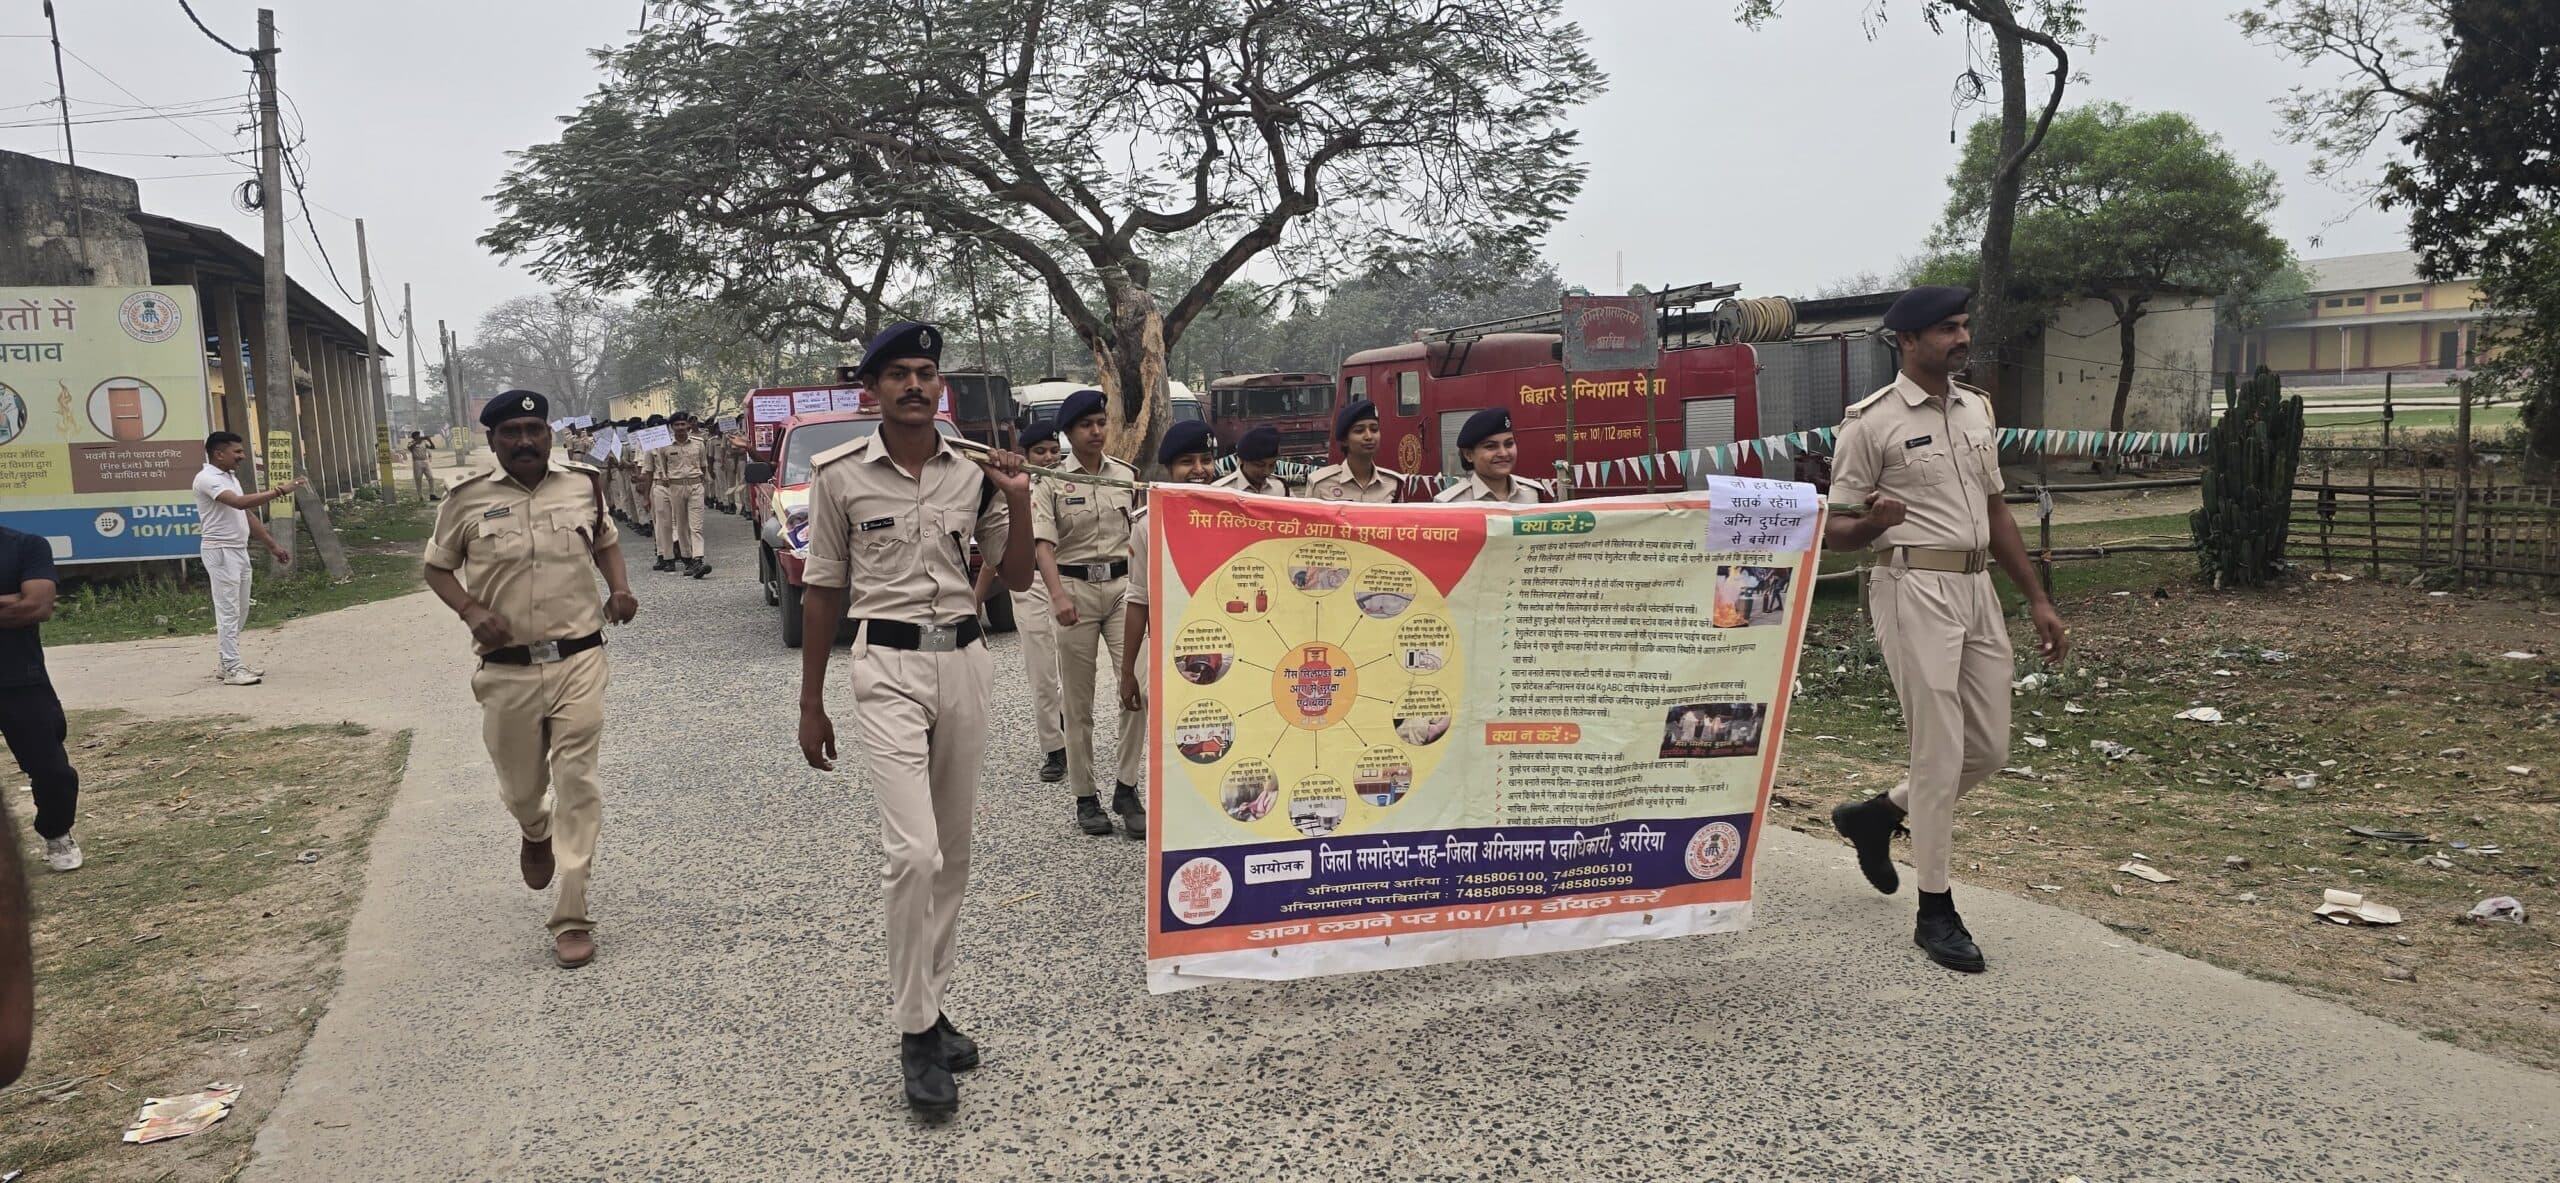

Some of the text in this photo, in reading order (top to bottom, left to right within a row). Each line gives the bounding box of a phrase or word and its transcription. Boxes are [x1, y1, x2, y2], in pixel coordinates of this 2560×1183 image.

[0, 299, 76, 330] तों में
[1519, 384, 1557, 405] बिहार
[134, 449, 156, 458] फायर
[100, 461, 121, 471] (Fire
[122, 460, 142, 471] Exit)
[270, 471, 291, 481] 15545
[1730, 494, 1798, 509] सतर्क रहेगा
[1187, 509, 1460, 544] गैस सिलेण्डर की आग से सुरक्षा एवं बचाव
[1520, 519, 1547, 533] क्या
[1551, 513, 1577, 532] करें
[1723, 513, 1802, 530] अग्नि दुर्घटना
[1730, 531, 1742, 545] से
[1748, 532, 1780, 545] बचेगा
[1284, 668, 1298, 679] गैस
[1491, 730, 1517, 743] क्या
[1520, 730, 1532, 741] न
[1536, 726, 1562, 742] करें
[1319, 842, 1353, 874] जिला
[1481, 832, 1546, 863] अग्निशमन
[1550, 827, 1615, 862] पदाधिकारी,
[1619, 823, 1667, 851] अररिया
[1249, 859, 1305, 875] आयोजक
[1306, 880, 1390, 896] अग्निशमालय
[1393, 875, 1441, 890] अररिया
[1455, 870, 1548, 885] 7485806100,
[1552, 862, 1633, 880] 7485806101
[1280, 896, 1362, 913] अग्निशमालय
[1365, 890, 1441, 905] फारबिसगंज
[1455, 884, 1548, 899] 7485805998,
[1550, 875, 1634, 893] 7485805999
[1247, 889, 1668, 941] आग लगने पर 101/112 डॉयल करें
